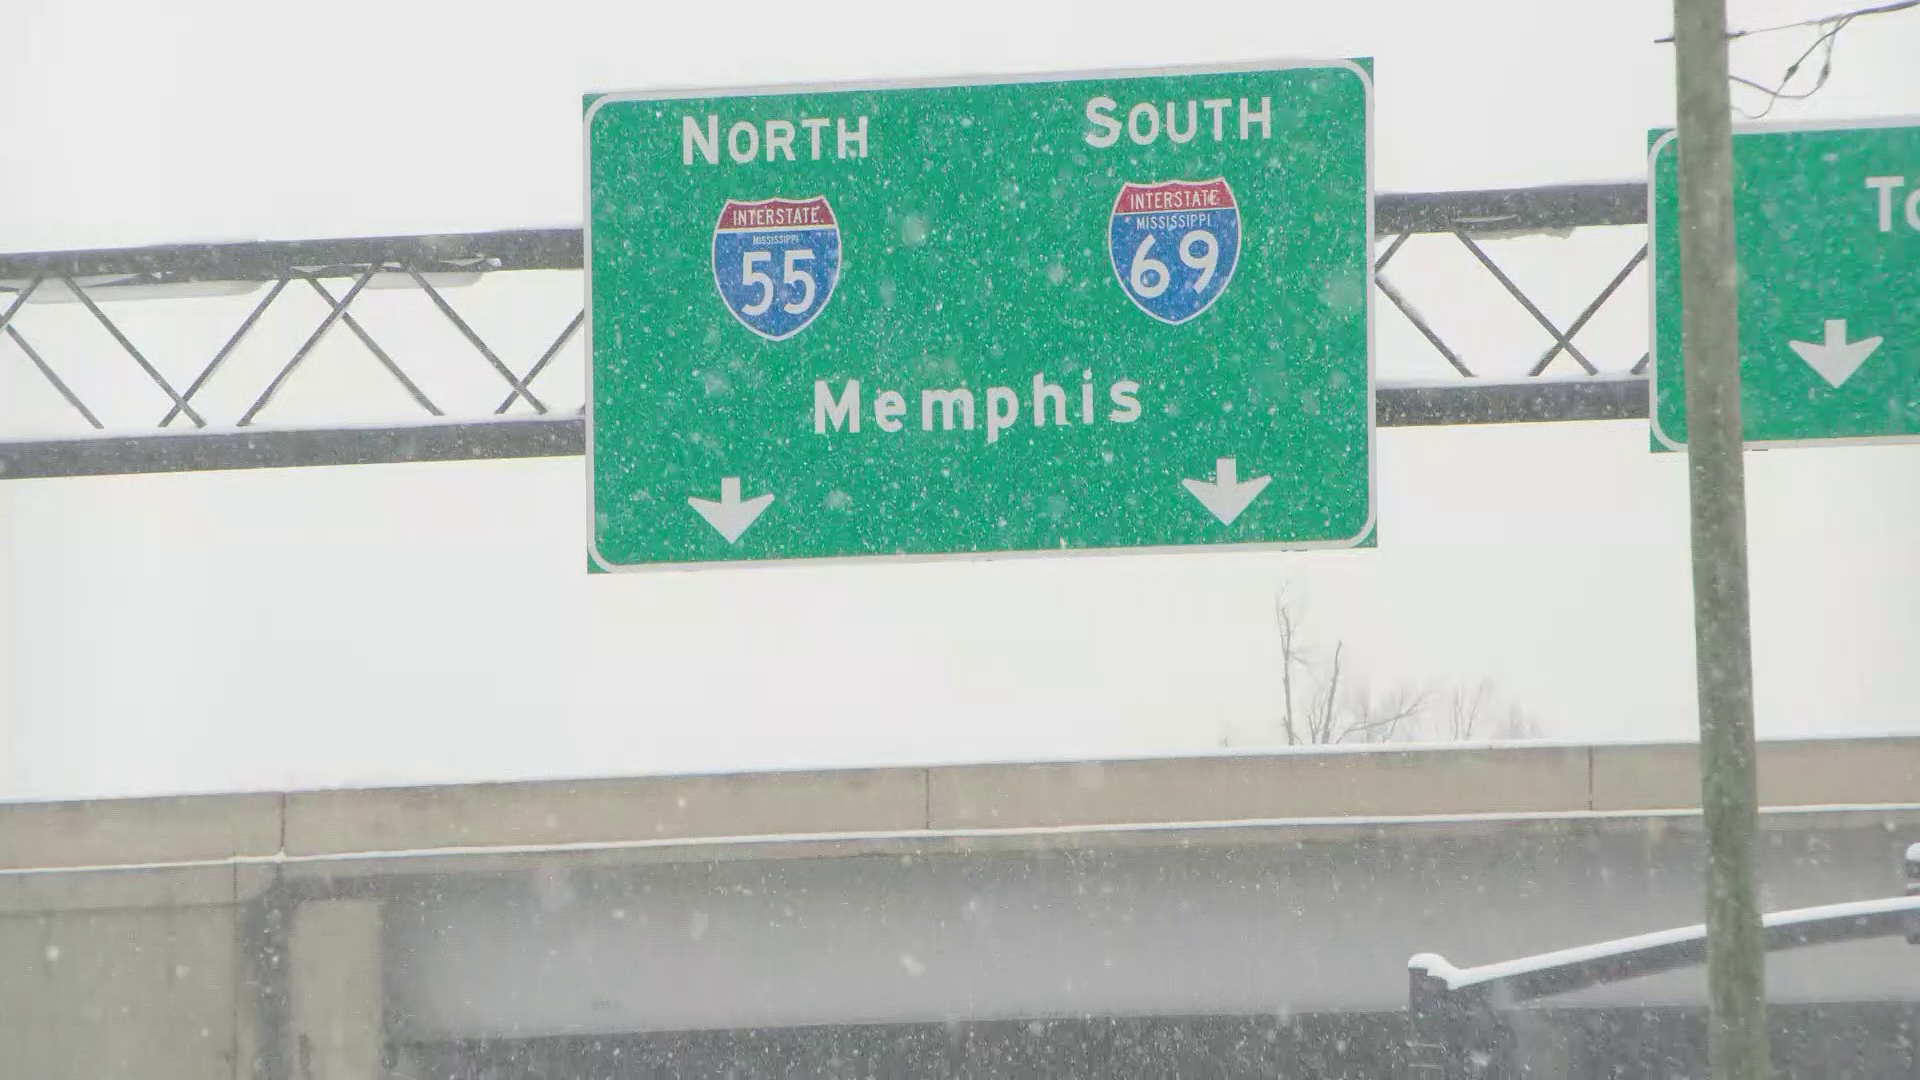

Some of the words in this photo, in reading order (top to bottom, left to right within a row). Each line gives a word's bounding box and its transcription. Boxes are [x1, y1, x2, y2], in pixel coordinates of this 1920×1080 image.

[682, 115, 868, 165] NORTH
[1085, 97, 1271, 148] SOUTH
[732, 205, 821, 227] INTERSTATE
[1129, 188, 1220, 211] INTERSTATE
[1136, 215, 1211, 230] MISSISSIPPI
[752, 234, 799, 246] MISSISSIPPI
[1130, 229, 1219, 299] 69
[740, 249, 817, 317] 55
[813, 369, 1142, 443] Memphis
